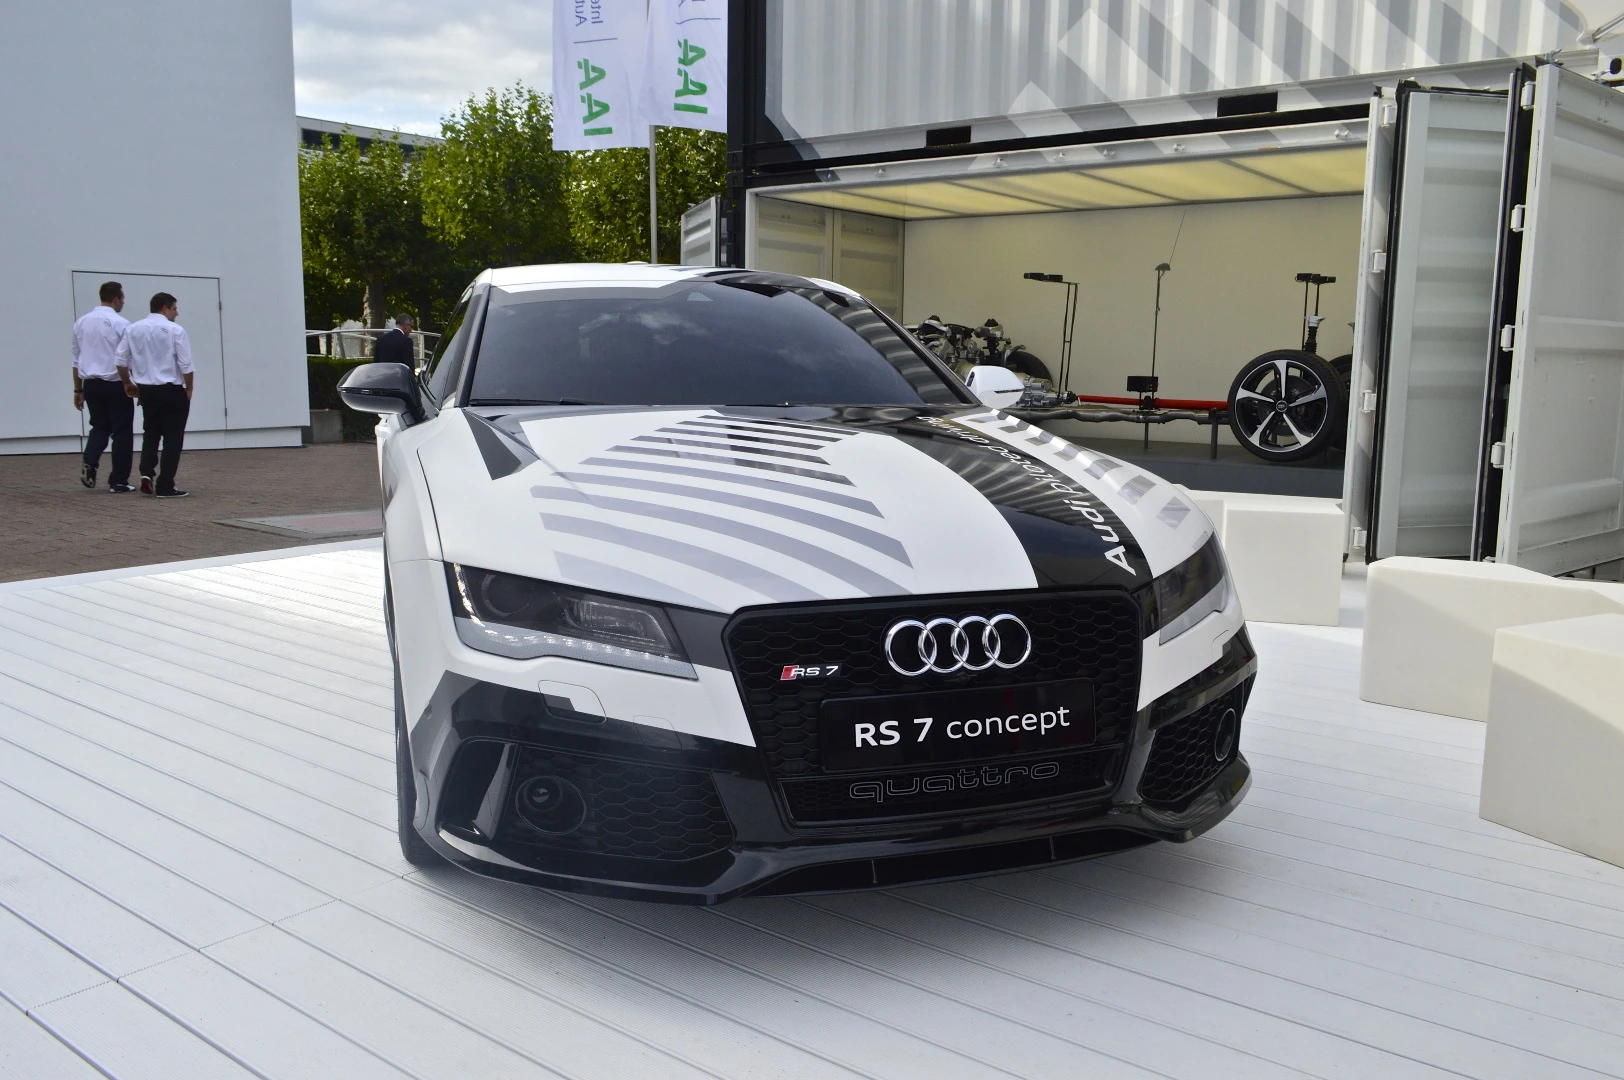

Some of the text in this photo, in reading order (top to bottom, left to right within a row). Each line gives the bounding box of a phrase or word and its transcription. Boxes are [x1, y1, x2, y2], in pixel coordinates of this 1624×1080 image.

[978, 445, 1083, 495] piloted
[1063, 499, 1137, 576] Audi
[790, 665, 839, 677] RS 7
[854, 706, 1071, 748] RS 7 concept
[850, 761, 1060, 803] quattro
